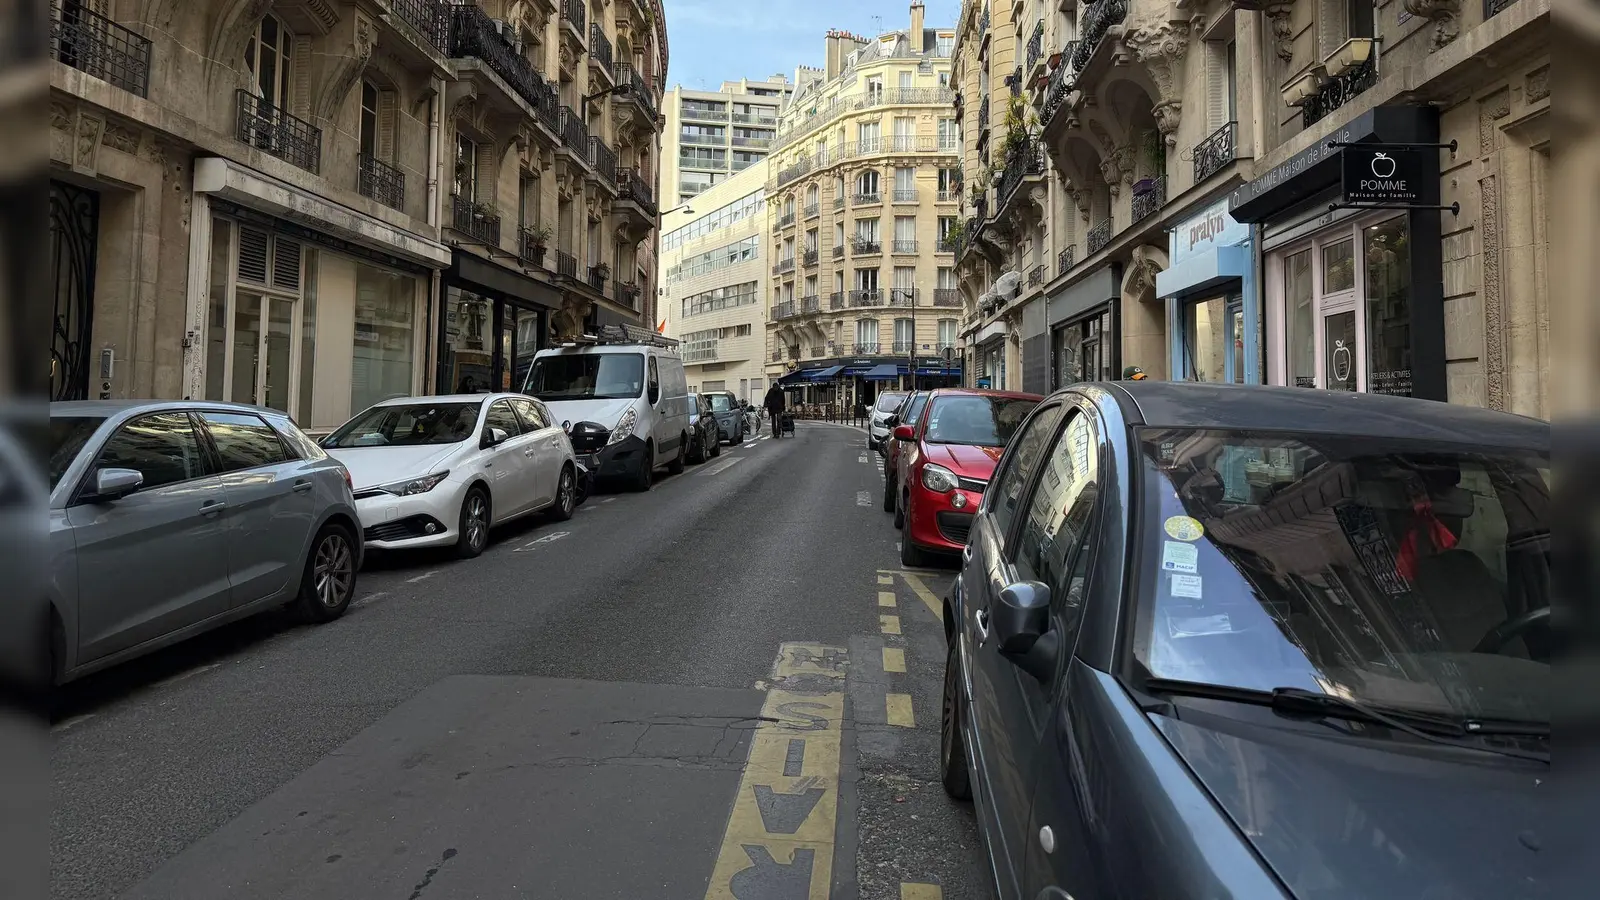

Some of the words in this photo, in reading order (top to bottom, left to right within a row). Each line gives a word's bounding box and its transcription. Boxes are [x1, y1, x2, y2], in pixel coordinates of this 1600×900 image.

[1251, 170, 1277, 196] POMME
[1278, 157, 1306, 181] Maison
[1307, 148, 1318, 164] de
[1360, 179, 1407, 191] POMME
[1189, 212, 1225, 252] pralyn
